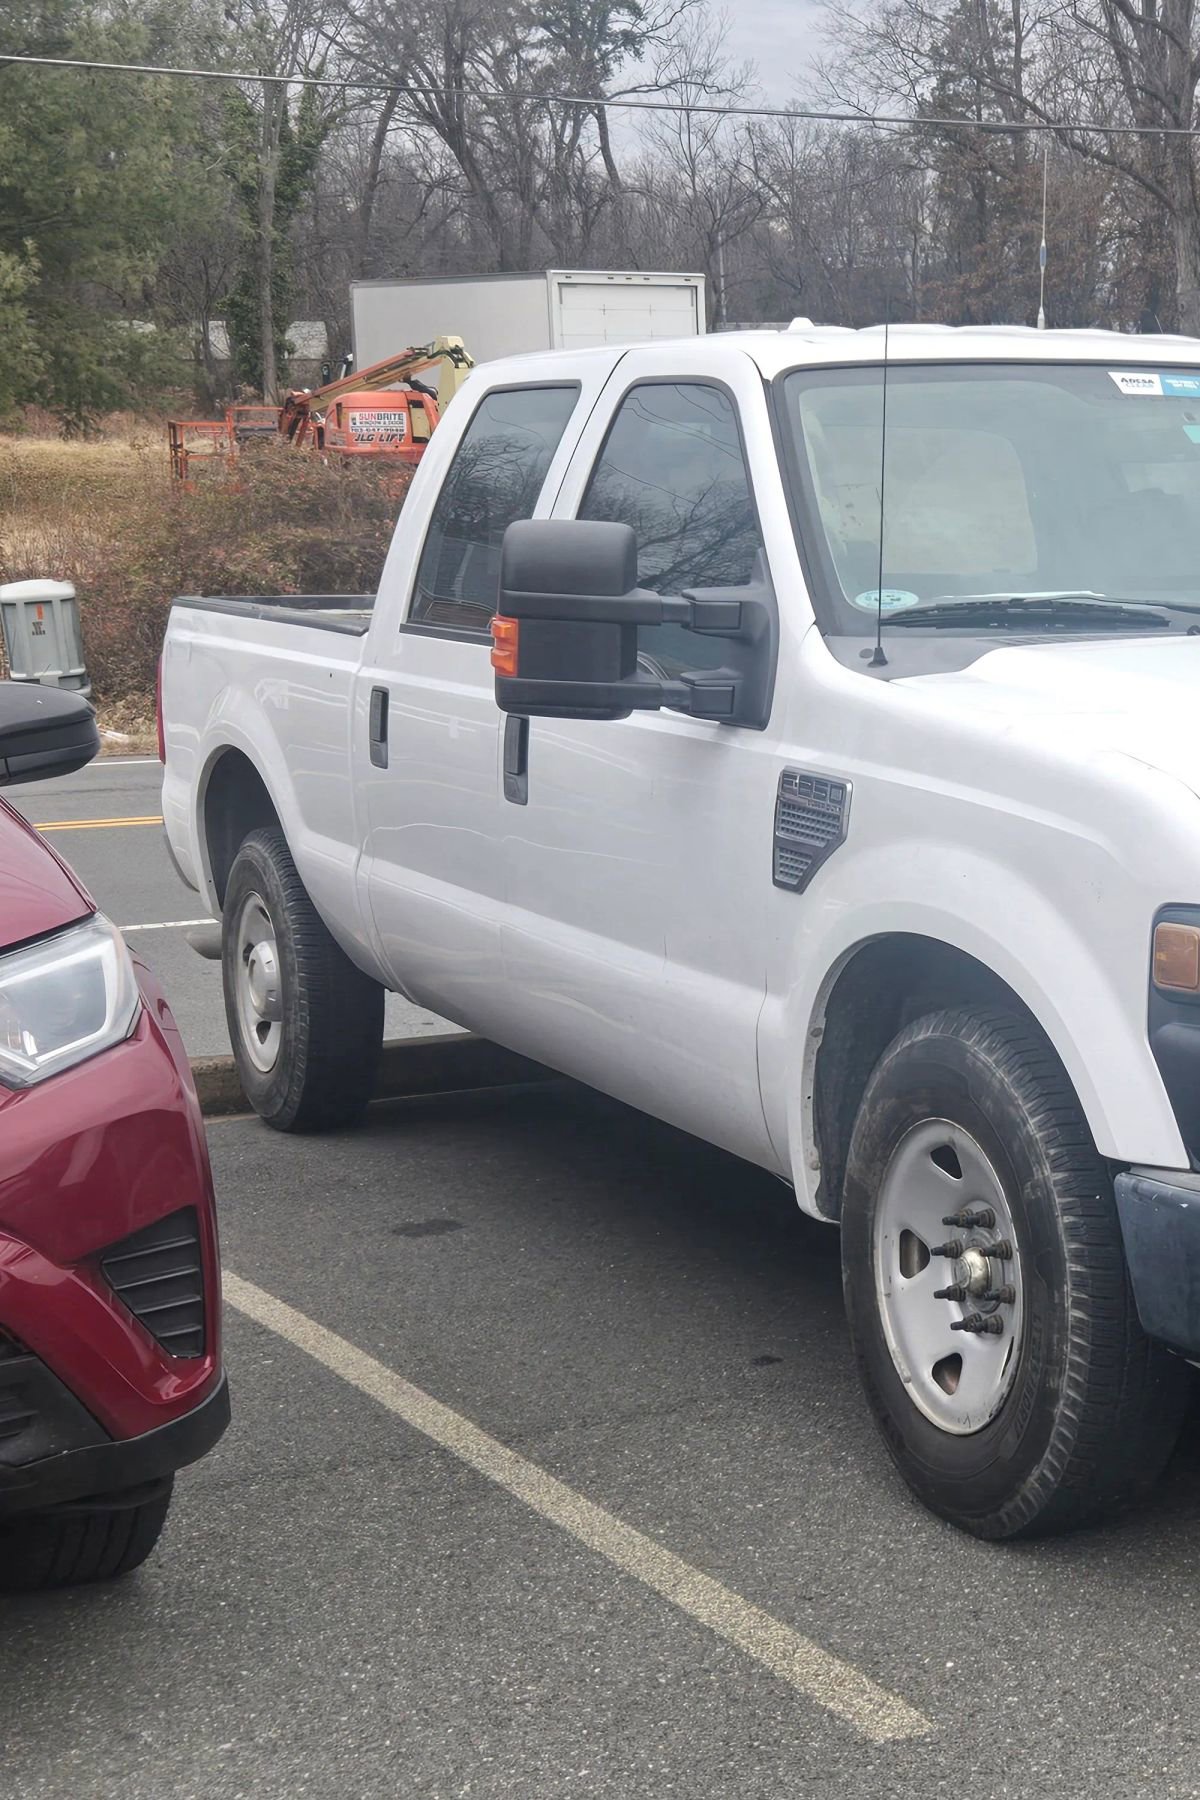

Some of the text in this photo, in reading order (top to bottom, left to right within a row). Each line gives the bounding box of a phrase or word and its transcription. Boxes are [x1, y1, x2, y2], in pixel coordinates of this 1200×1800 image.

[359, 413, 404, 421] SUNBRITE
[355, 433, 405, 442] JLG LIFT
